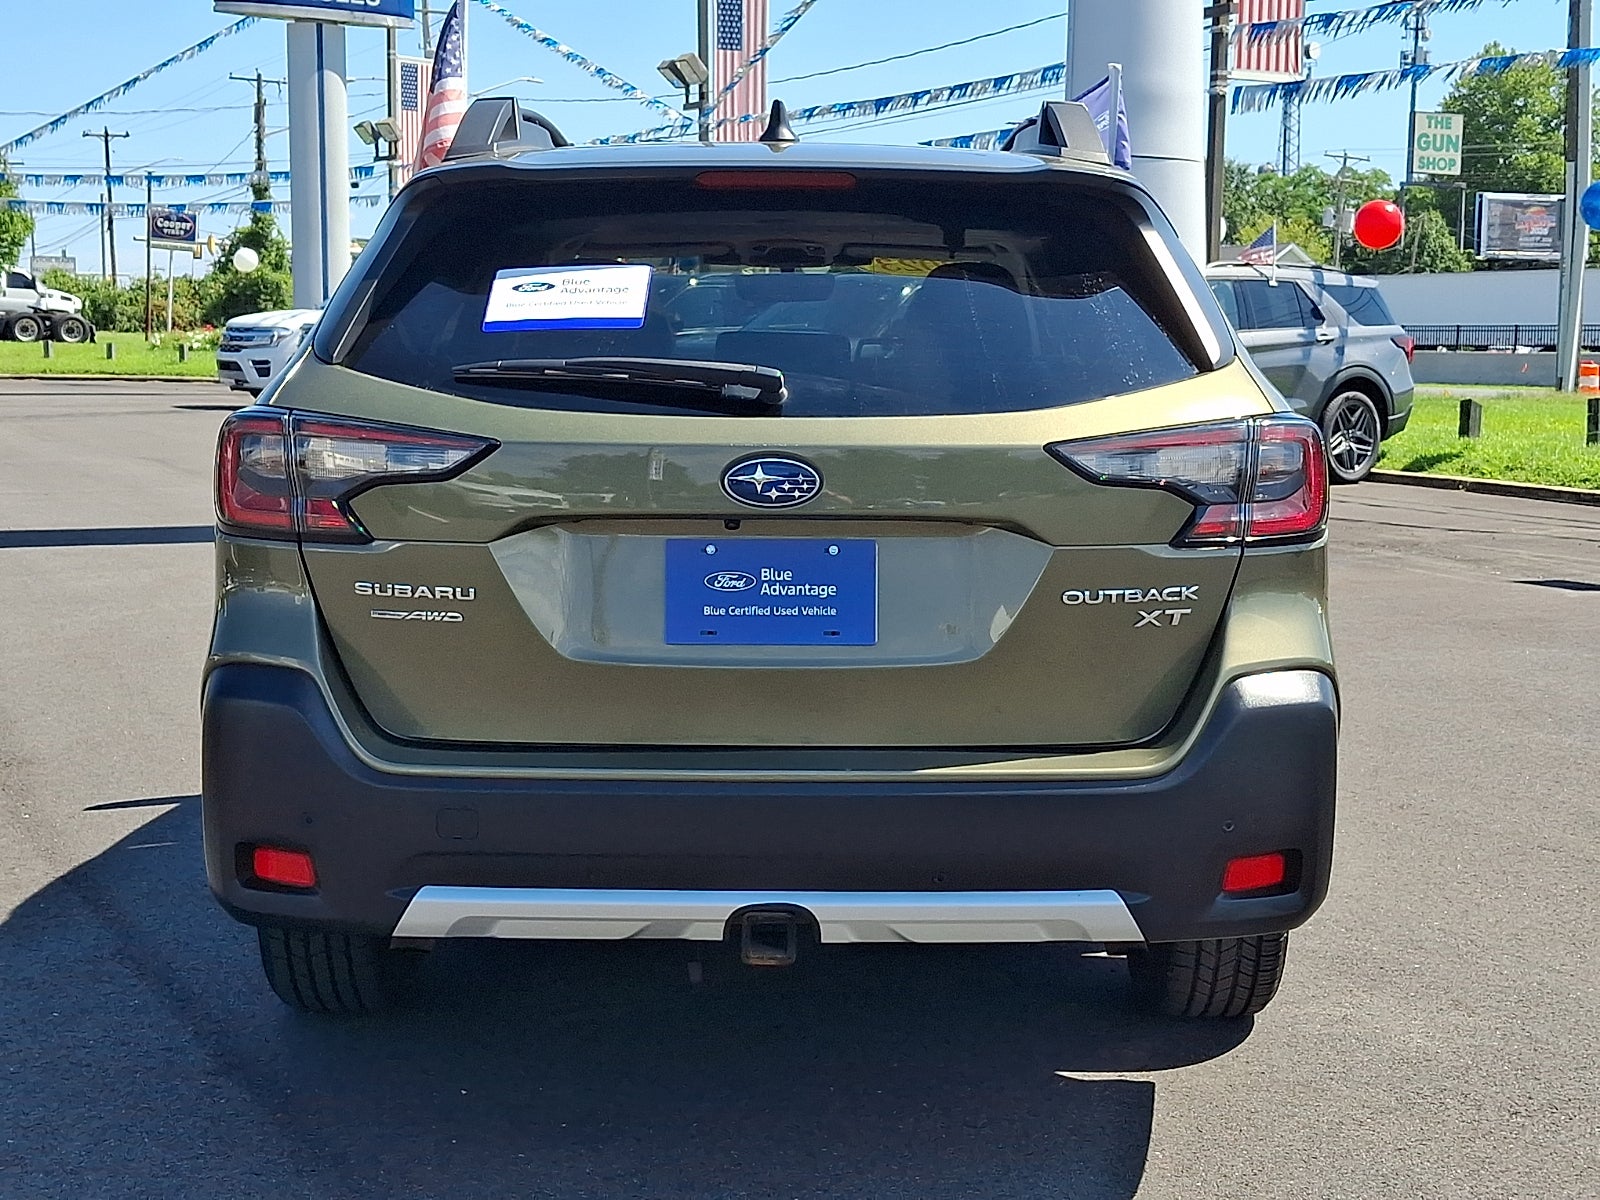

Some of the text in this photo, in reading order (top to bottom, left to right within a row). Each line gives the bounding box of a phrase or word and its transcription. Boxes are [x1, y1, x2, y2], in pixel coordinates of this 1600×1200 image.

[1426, 115, 1452, 129] THE
[1417, 133, 1459, 152] GUN
[1418, 156, 1457, 171] SHOP
[714, 574, 746, 588] Ford
[761, 568, 793, 581] Blue
[354, 582, 475, 600] SUBARU
[760, 583, 837, 598] Advantage
[1062, 585, 1200, 605] OUTBACK
[404, 611, 464, 622] AWD
[703, 605, 837, 616] Blue Certified Used Vehicle
[1134, 608, 1192, 627] XT
